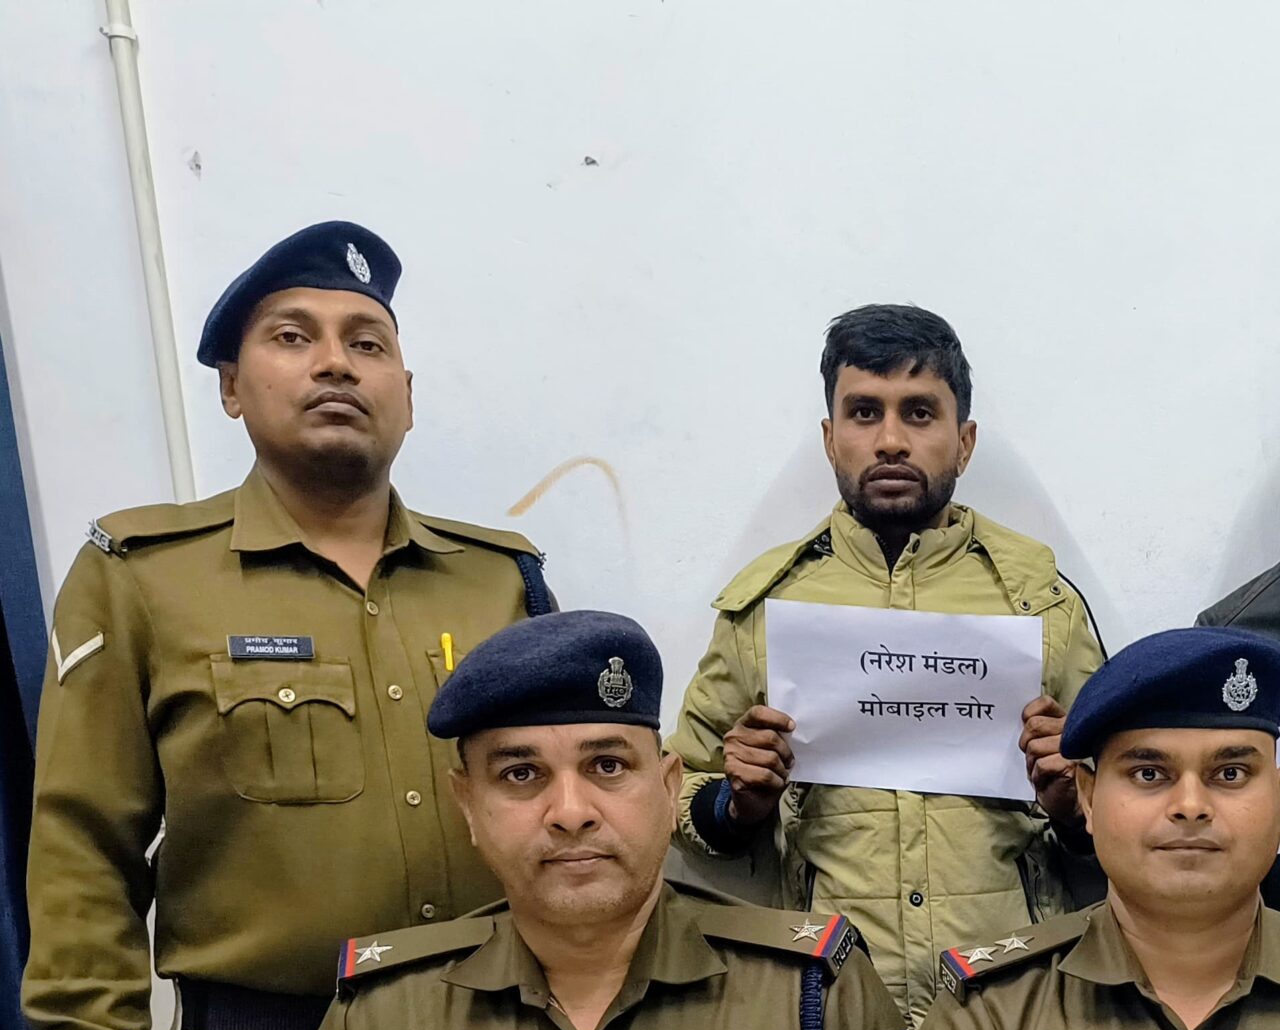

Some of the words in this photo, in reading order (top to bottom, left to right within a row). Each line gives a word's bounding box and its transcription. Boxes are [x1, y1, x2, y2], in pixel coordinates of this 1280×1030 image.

[246, 646, 274, 654] PRAMOD
[275, 646, 299, 654] KUMAR
[860, 644, 916, 675] (नरेश
[921, 651, 989, 680] मंडल)
[857, 693, 949, 722] मोबाइल
[954, 695, 995, 721] चोर
